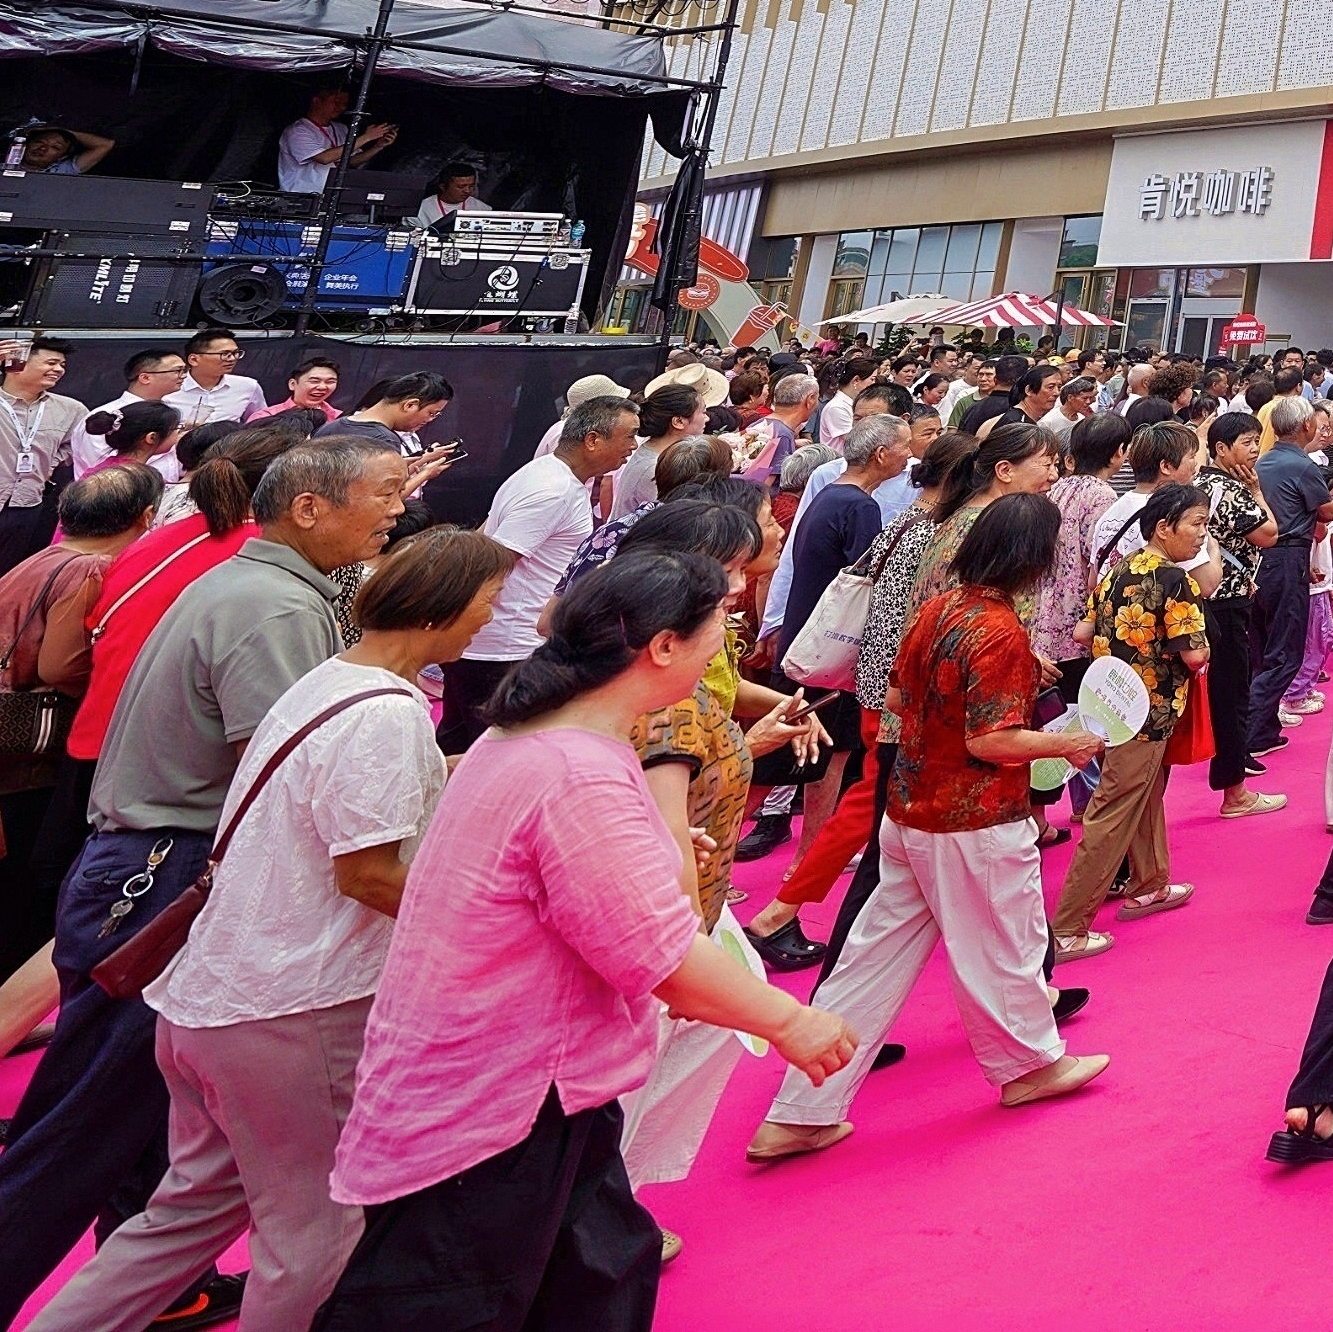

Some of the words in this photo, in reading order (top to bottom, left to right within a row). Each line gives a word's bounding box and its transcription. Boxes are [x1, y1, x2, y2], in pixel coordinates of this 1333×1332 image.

[1137, 165, 1273, 221] 肯悦咖啡
[1229, 329, 1259, 341] 免费试饮
